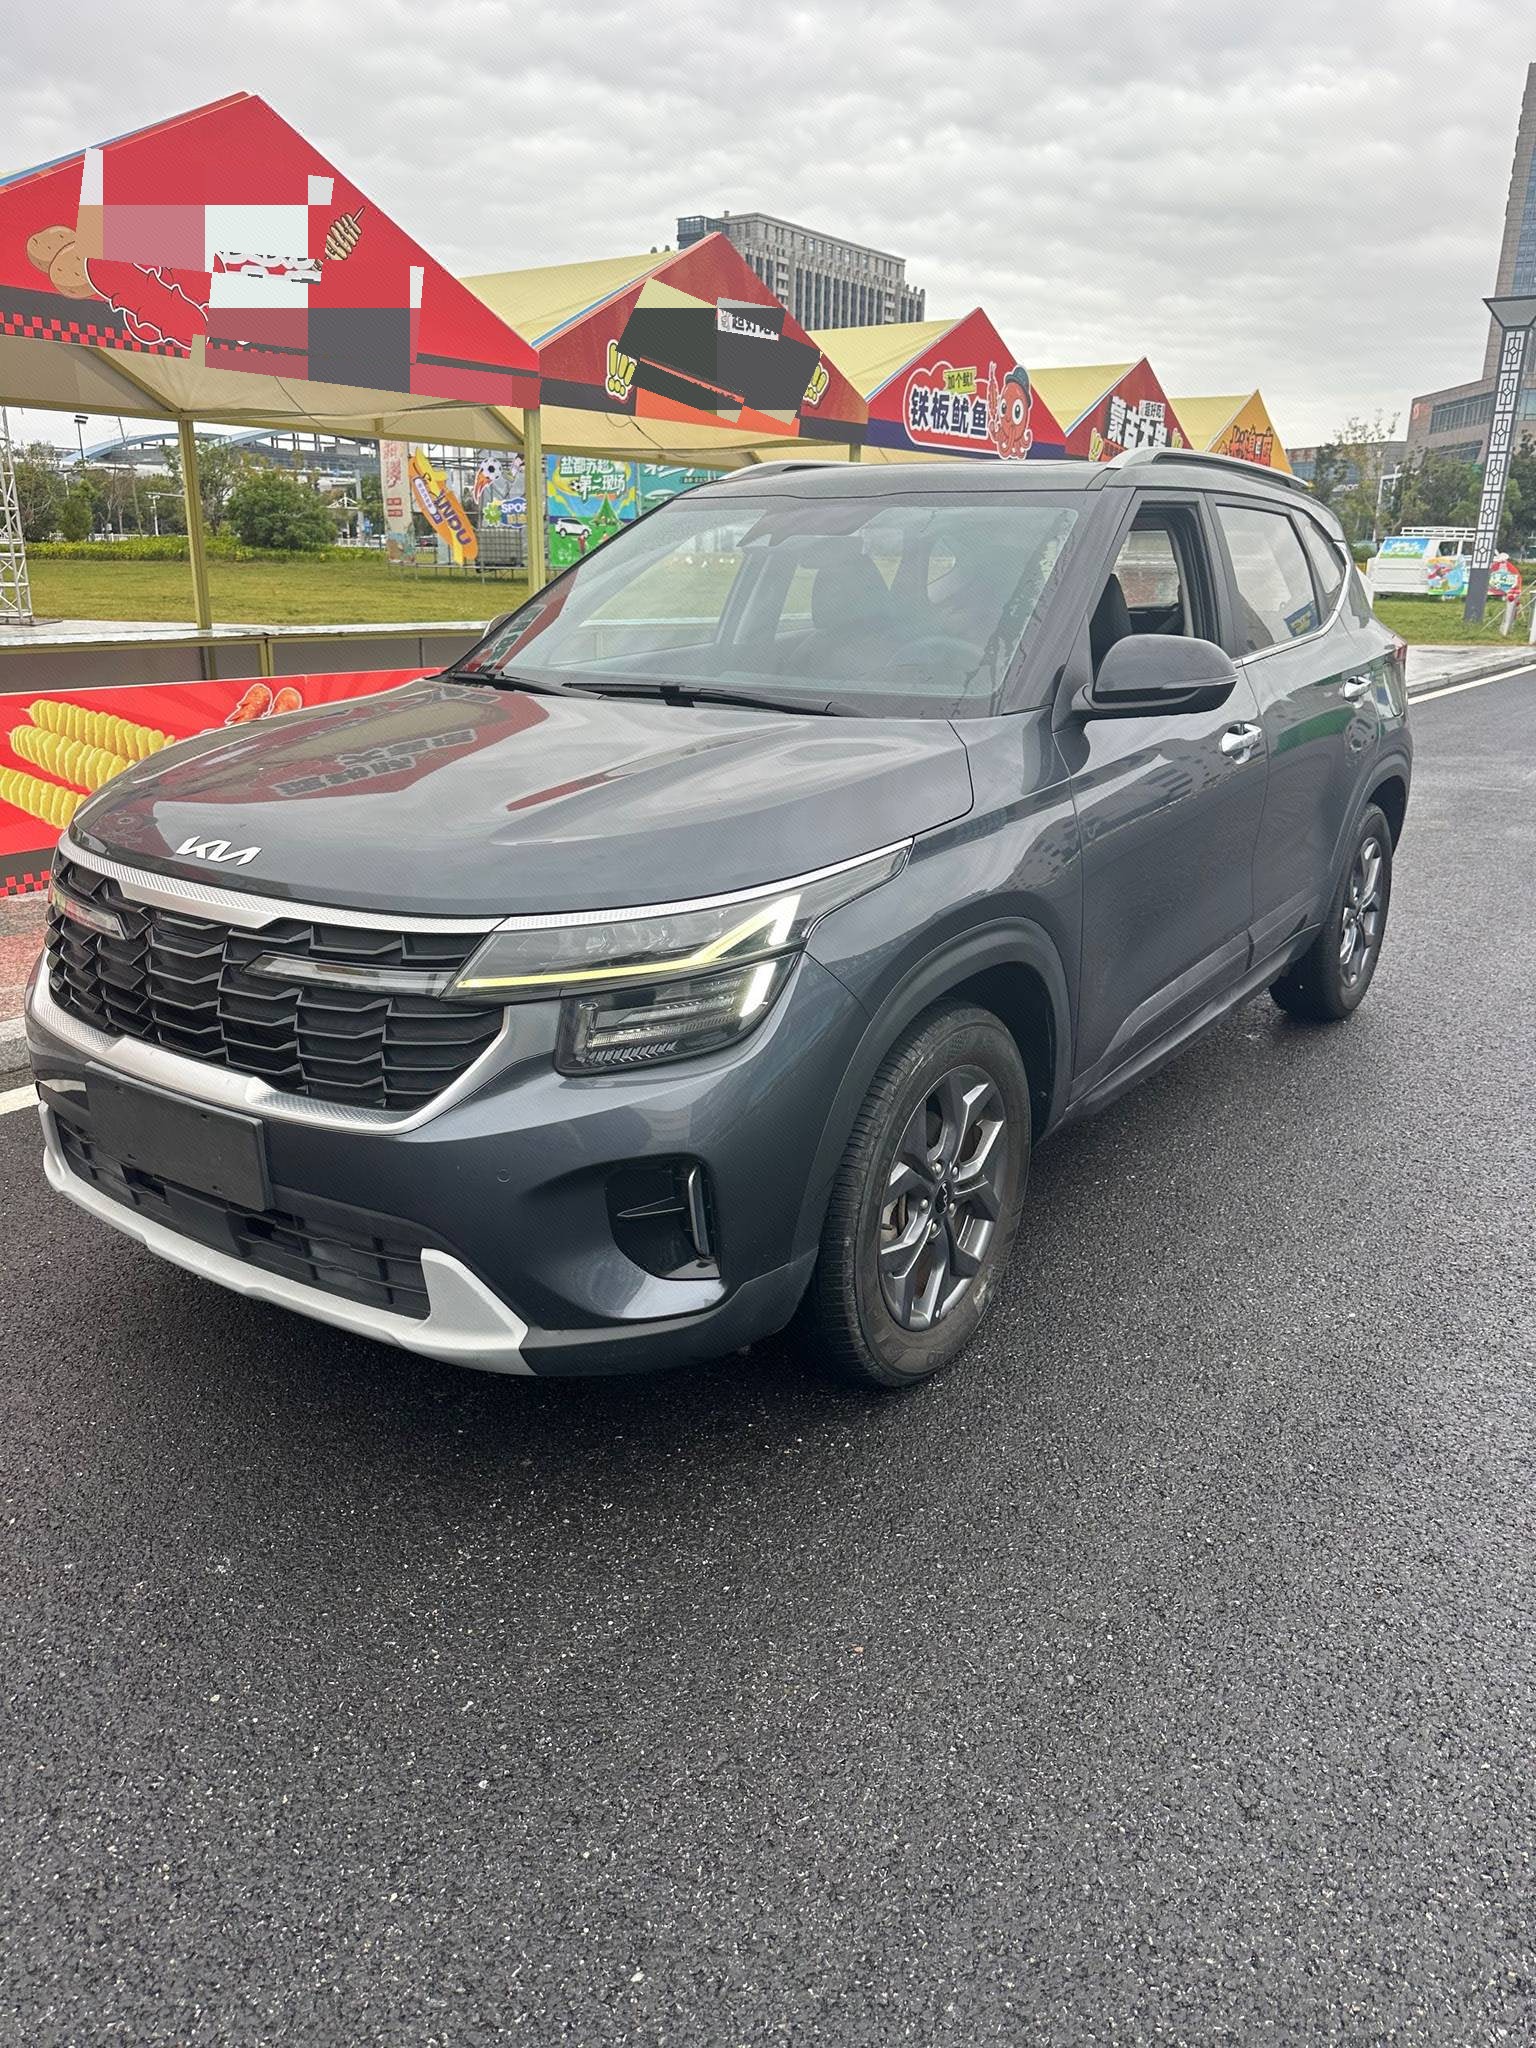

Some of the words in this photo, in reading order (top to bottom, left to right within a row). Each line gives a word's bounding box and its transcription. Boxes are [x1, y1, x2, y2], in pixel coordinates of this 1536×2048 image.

[911, 388, 987, 437] 铁板鱿鱼
[176, 835, 262, 867] KIA
